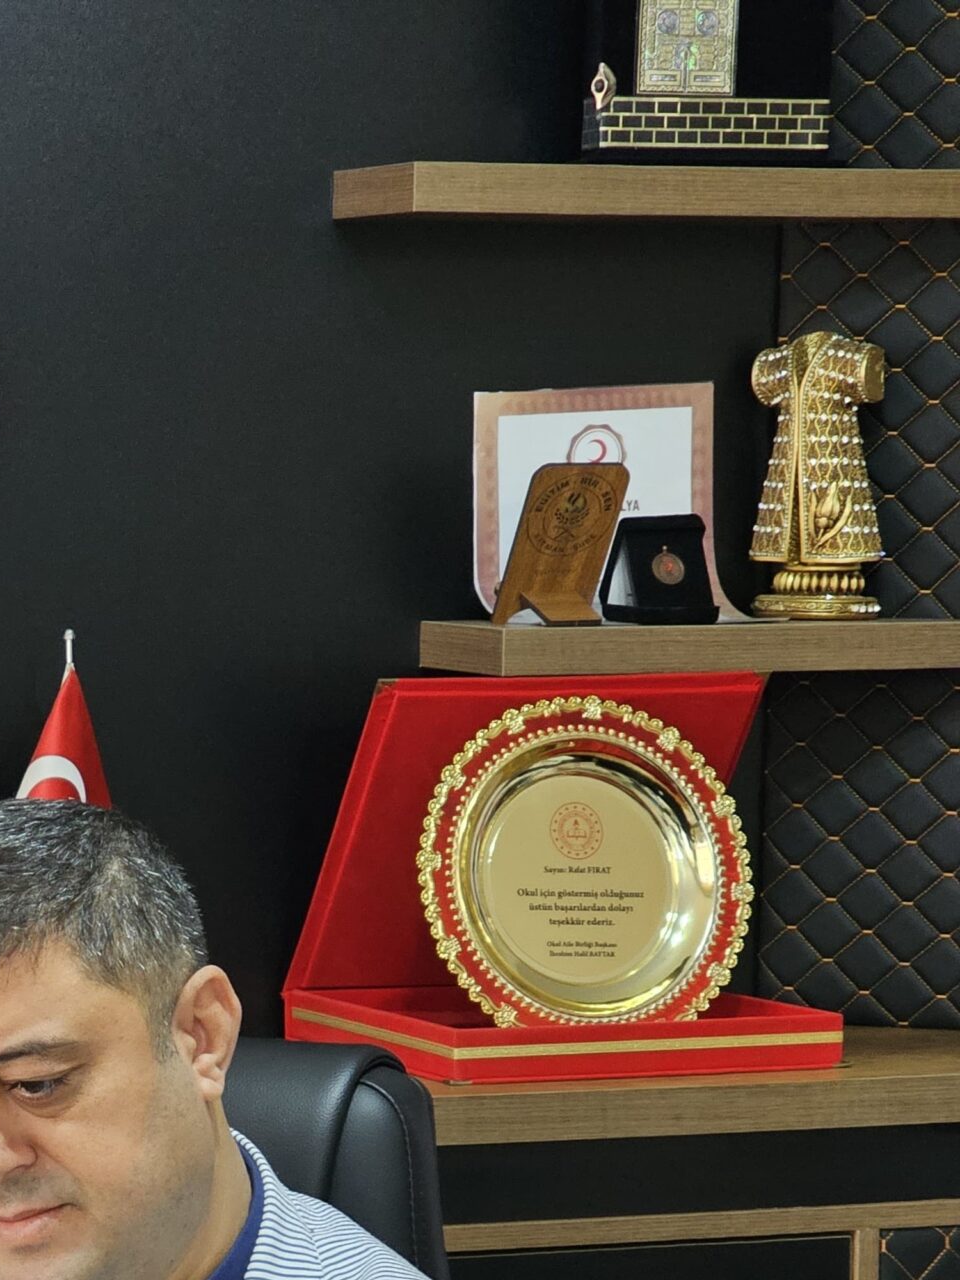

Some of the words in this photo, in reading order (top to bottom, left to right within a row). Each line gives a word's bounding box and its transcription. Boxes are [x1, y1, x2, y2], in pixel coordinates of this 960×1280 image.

[587, 866, 612, 874] FIRAT
[516, 888, 538, 897] Okul
[540, 889, 556, 899] için
[557, 889, 599, 900] göstermiş
[600, 889, 645, 900] olduğunuz
[529, 903, 553, 912] üstün
[554, 903, 607, 914] başarılardan
[608, 904, 634, 914] dolayı
[549, 918, 585, 928] teşekkür
[586, 918, 616, 926] ederiz.
